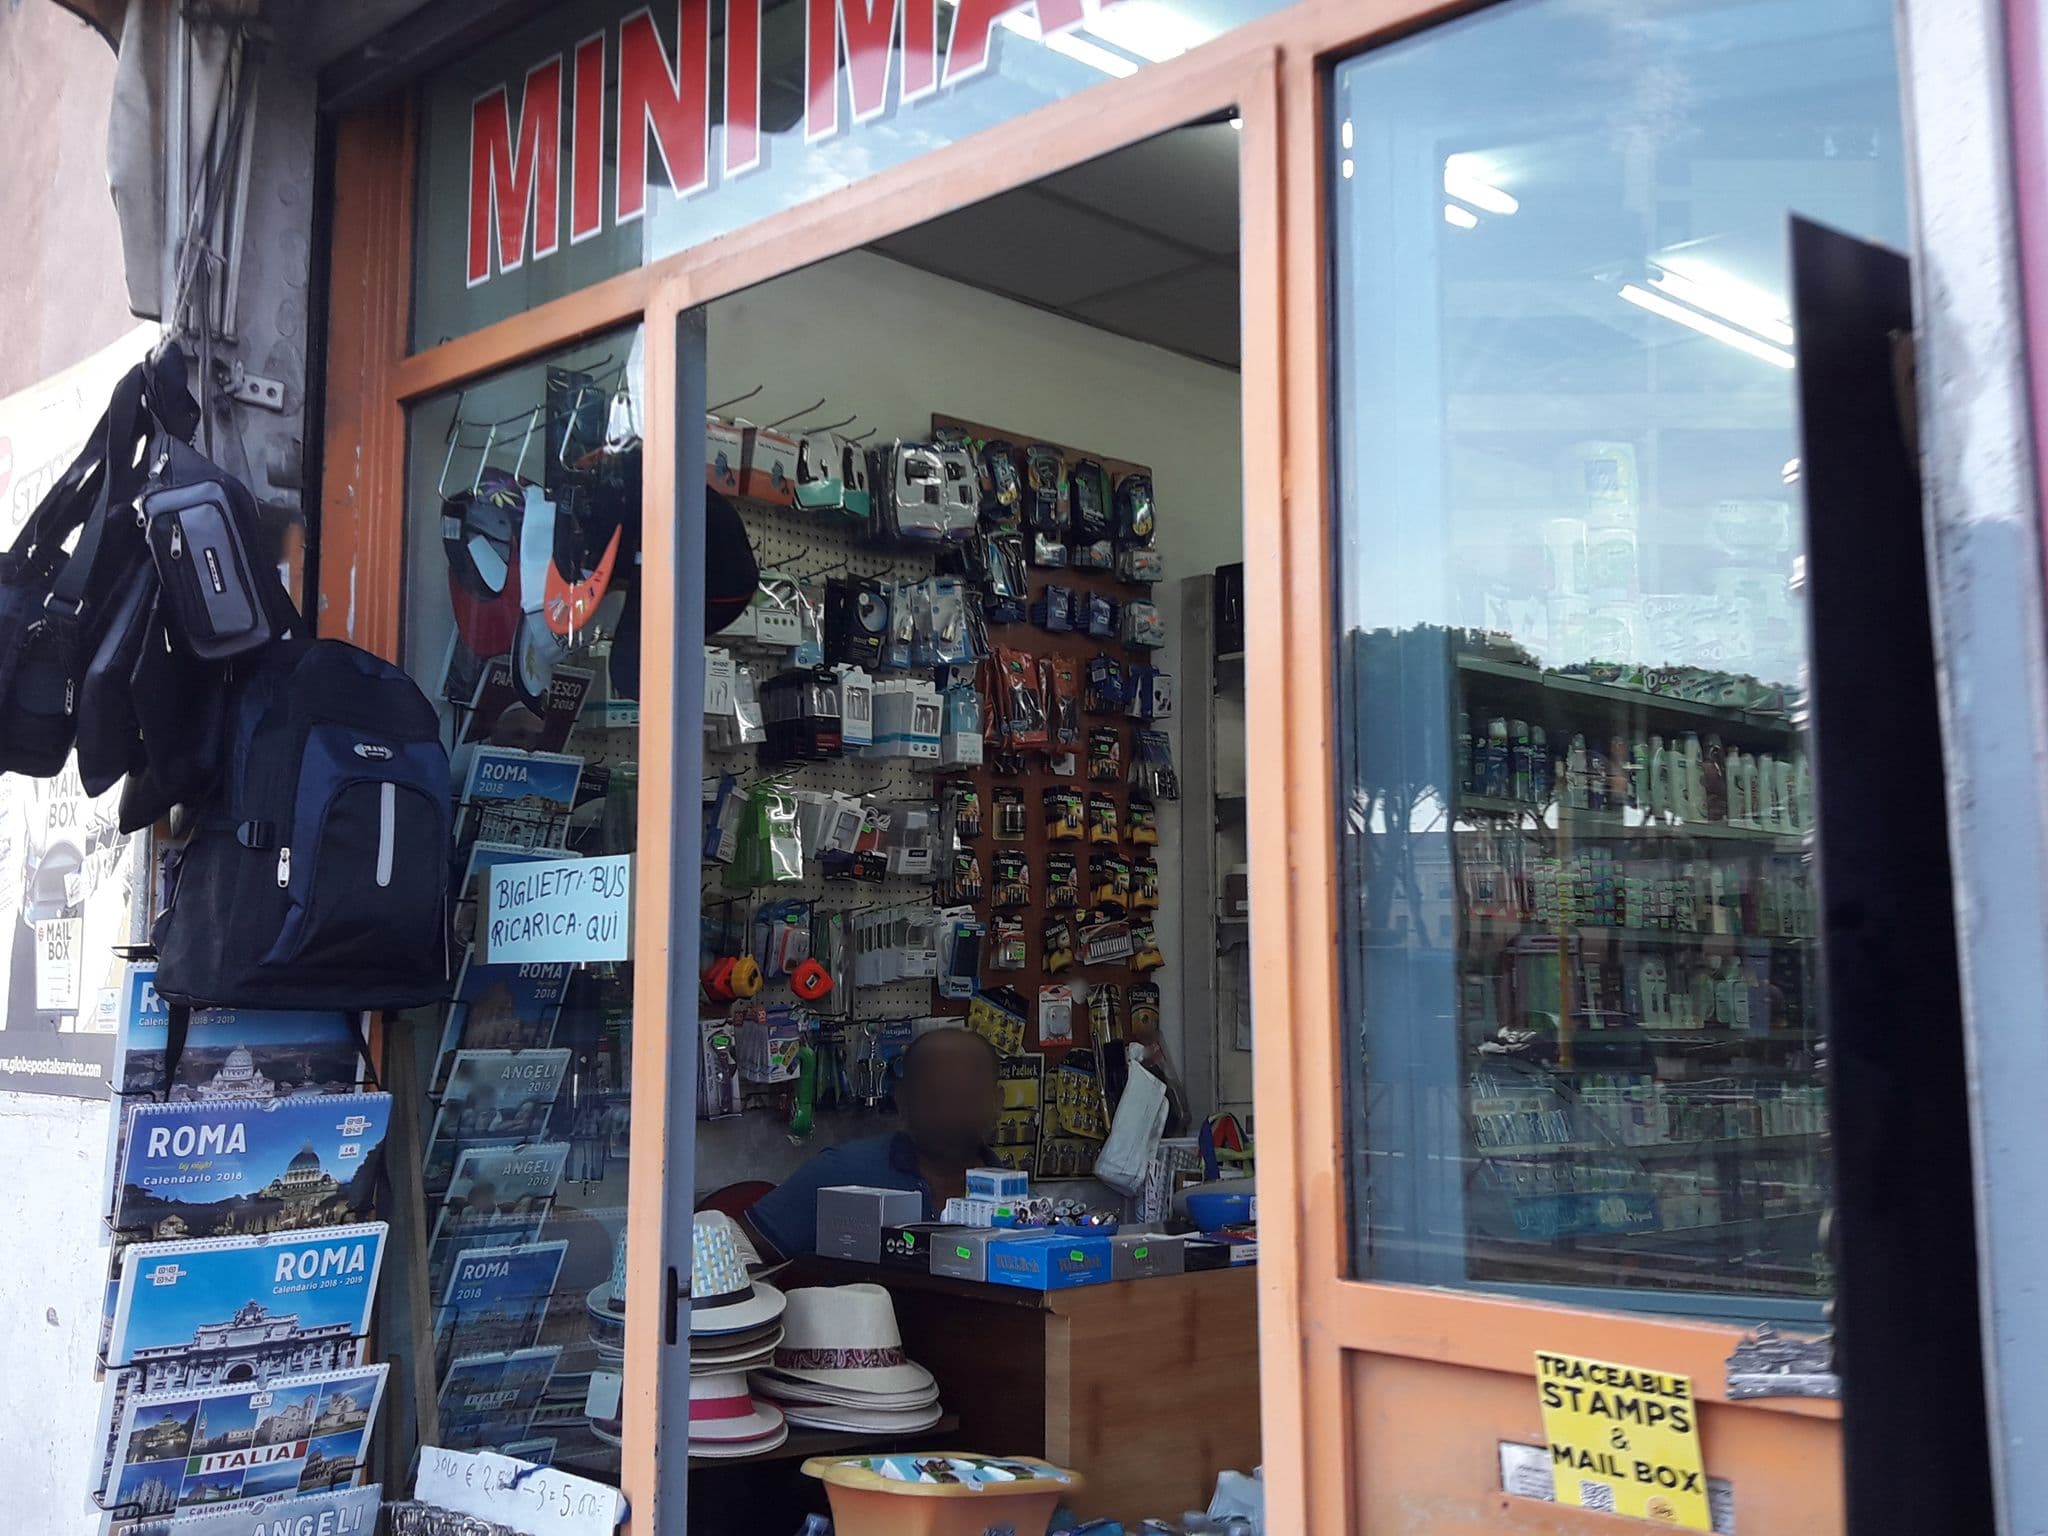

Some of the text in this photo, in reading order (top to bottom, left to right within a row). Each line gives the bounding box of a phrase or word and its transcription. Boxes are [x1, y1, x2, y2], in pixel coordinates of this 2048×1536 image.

[466, 0, 761, 289] MINI
[482, 762, 528, 782] ROMA
[49, 802, 77, 828] BOX
[589, 865, 627, 899] BUS
[46, 922, 72, 941] MAIL
[48, 941, 70, 960] BOX
[518, 963, 563, 979] ROMA
[501, 1064, 558, 1079] ANGELI
[147, 1122, 247, 1158] ROMA
[143, 1173, 212, 1186] Calendario
[502, 1159, 557, 1176] ANGELI
[274, 1244, 365, 1283] ROMA
[462, 1261, 510, 1280] ROMA
[272, 1282, 318, 1296] Calendario
[1538, 1355, 1687, 1400] TRACEABLE
[1542, 1381, 1691, 1434] STAMPS
[204, 1445, 293, 1472] ITALIA
[1551, 1443, 1626, 1479] MAIL
[1633, 1459, 1703, 1496] BOX
[252, 1504, 364, 1536] ANGELI
